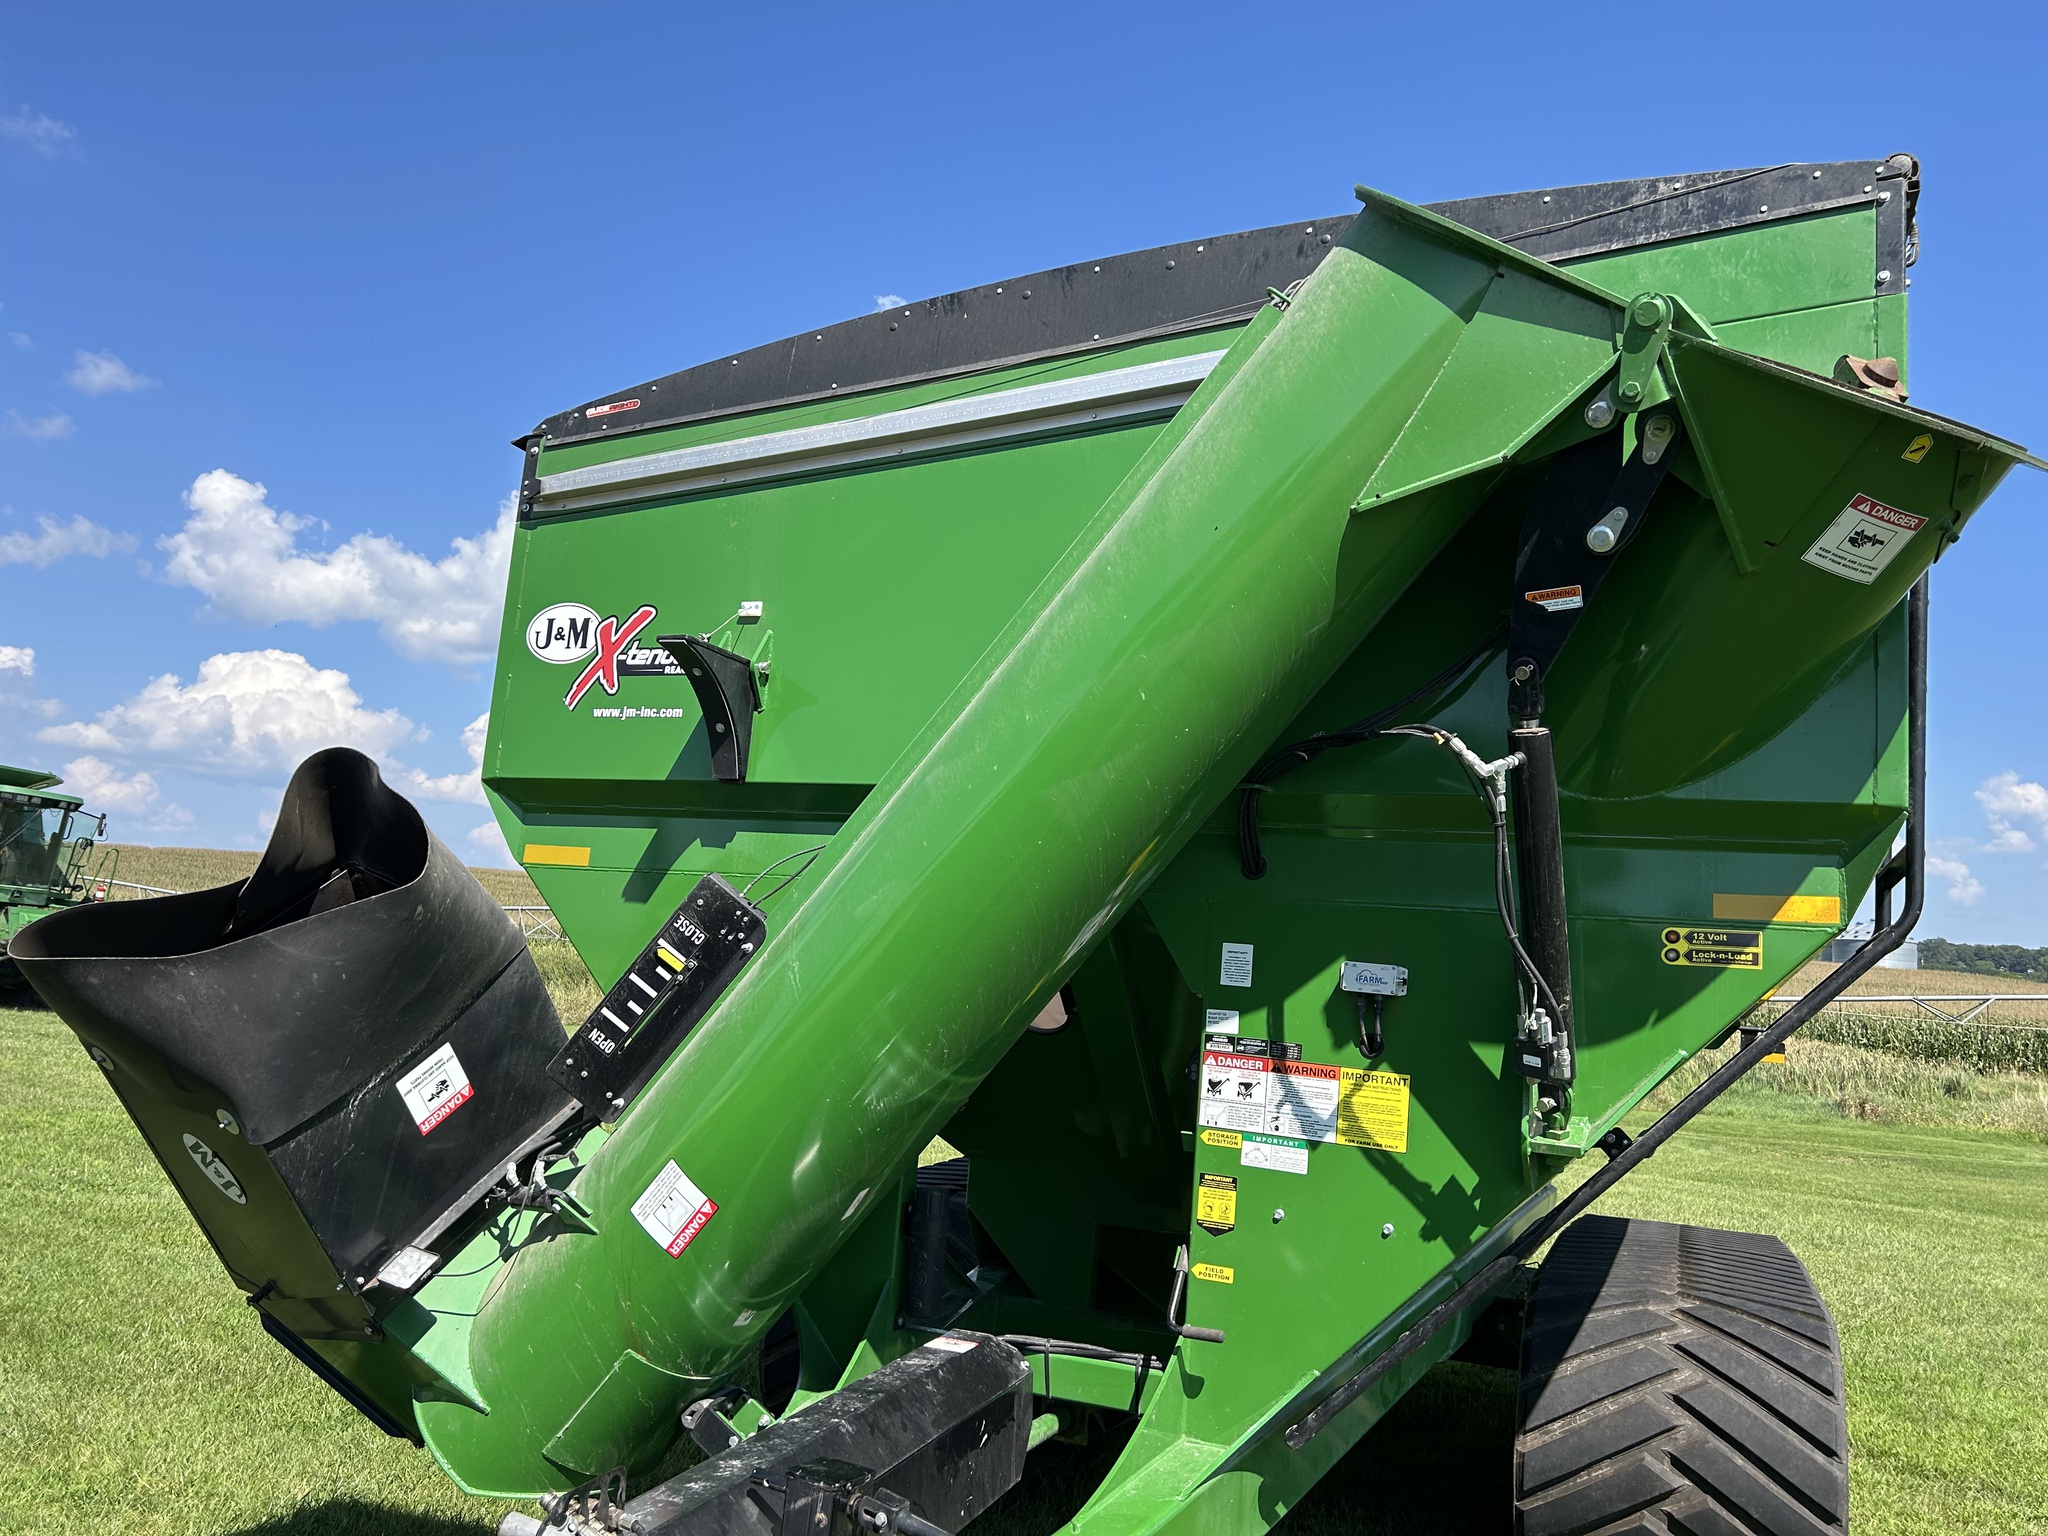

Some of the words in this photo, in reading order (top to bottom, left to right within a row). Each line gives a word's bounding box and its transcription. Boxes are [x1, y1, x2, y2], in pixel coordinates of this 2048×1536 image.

[1871, 506, 1918, 528] DANGER
[1831, 552, 1847, 561] HANDS
[1857, 562, 1878, 571] CLOTHING
[1841, 563, 1859, 571] MOVING
[1538, 589, 1576, 599] WARNING
[535, 617, 591, 650] J&M
[593, 706, 683, 720] www.jm-inc.com
[673, 914, 707, 945] CLOSE
[1693, 932, 1704, 940] 12
[1707, 933, 1727, 941] Volt
[1692, 951, 1752, 960] Lock-n-Load
[588, 1028, 616, 1054] OPEN
[1217, 1056, 1263, 1071] DANGER
[1284, 1064, 1337, 1079] WARNING
[1342, 1071, 1408, 1087] IMPORTANT
[420, 1093, 463, 1132] DANGER
[1207, 1132, 1239, 1140] STORAGE
[1207, 1137, 1239, 1146] POSITION
[1252, 1135, 1299, 1147] IMPORTANT
[188, 1140, 244, 1200] J&M
[1204, 1174, 1233, 1183] IMPORTANT
[669, 1213, 706, 1255] DANGER
[1199, 1271, 1230, 1281] POSITION
[1205, 1266, 1224, 1274] FIELD
